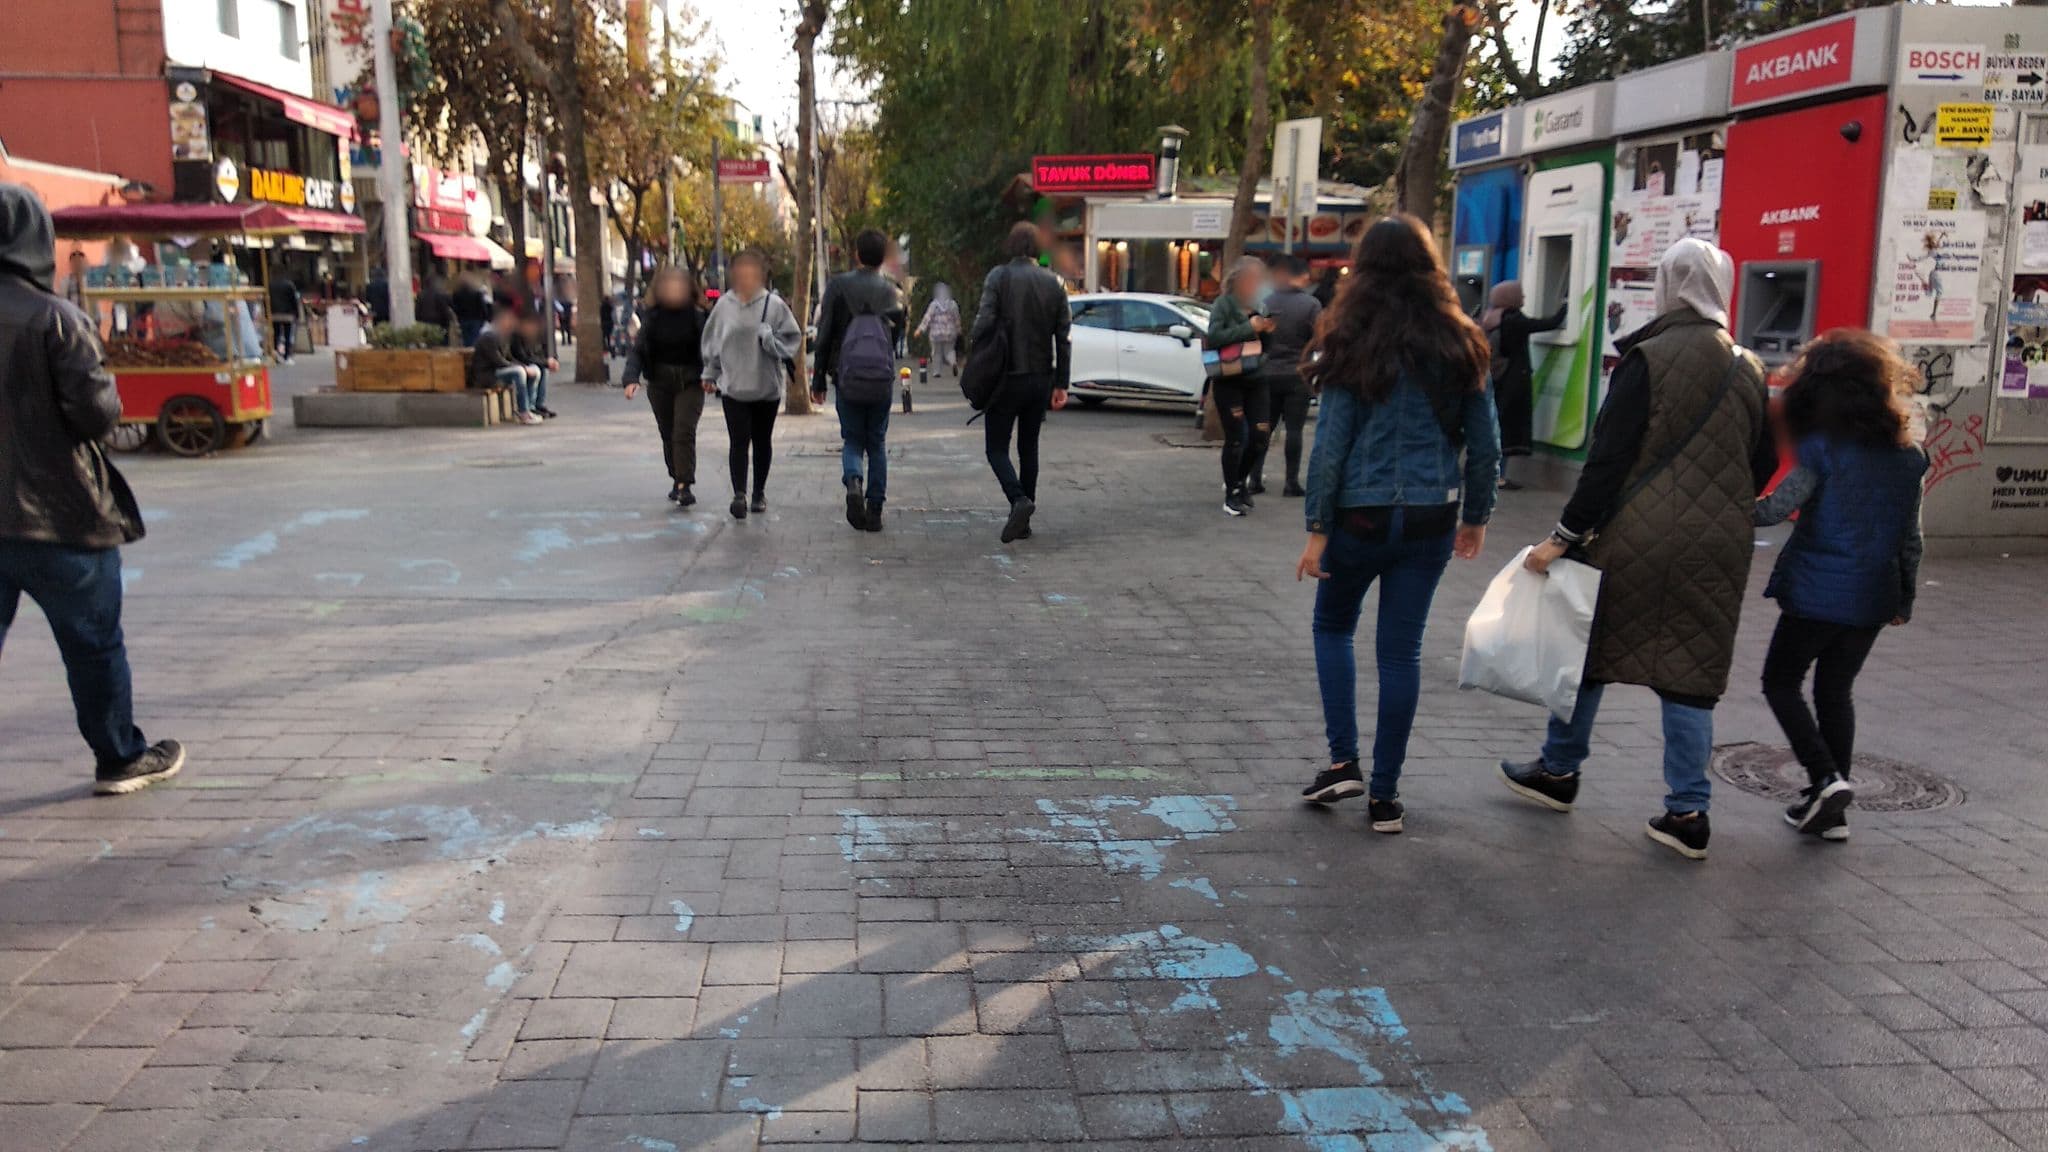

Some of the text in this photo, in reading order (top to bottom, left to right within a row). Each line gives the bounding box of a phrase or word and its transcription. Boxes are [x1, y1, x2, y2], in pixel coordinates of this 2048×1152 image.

[1746, 42, 1839, 85] AKBANK
[1909, 51, 1980, 70] BOSCH
[1986, 54, 2046, 69] BÜYÜK BEDEN
[1984, 88, 2003, 100] BAY
[2011, 89, 2044, 101] BAYAN
[1038, 162, 1150, 183] TAVUK DÖNER
[251, 167, 334, 209] DARLING CAFE
[1760, 204, 1821, 225] AKBANK
[1992, 487, 2015, 496] HER
